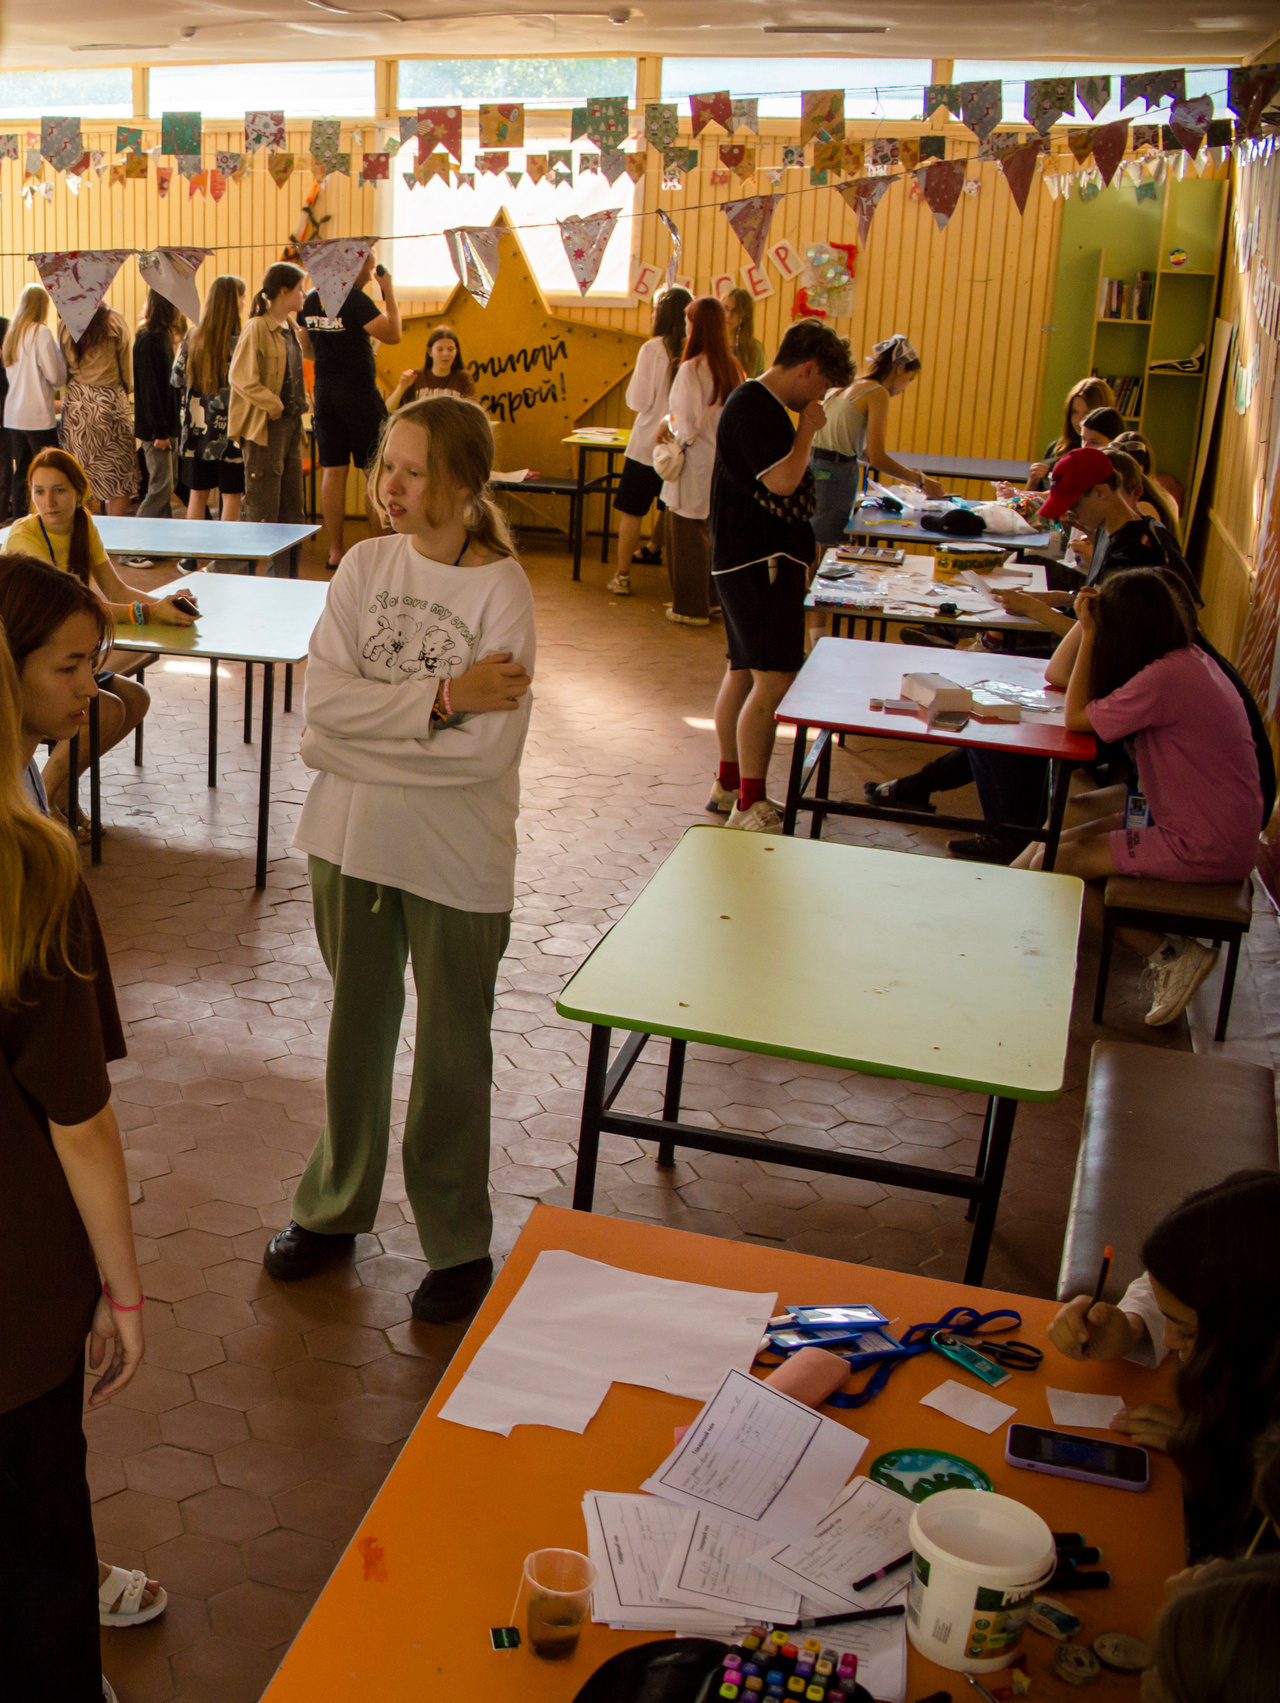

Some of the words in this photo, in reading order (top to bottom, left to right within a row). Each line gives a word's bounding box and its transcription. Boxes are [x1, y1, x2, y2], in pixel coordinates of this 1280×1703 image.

[634, 245, 793, 300] БСЕР
[402, 596, 429, 610] are
[430, 602, 453, 621] my
